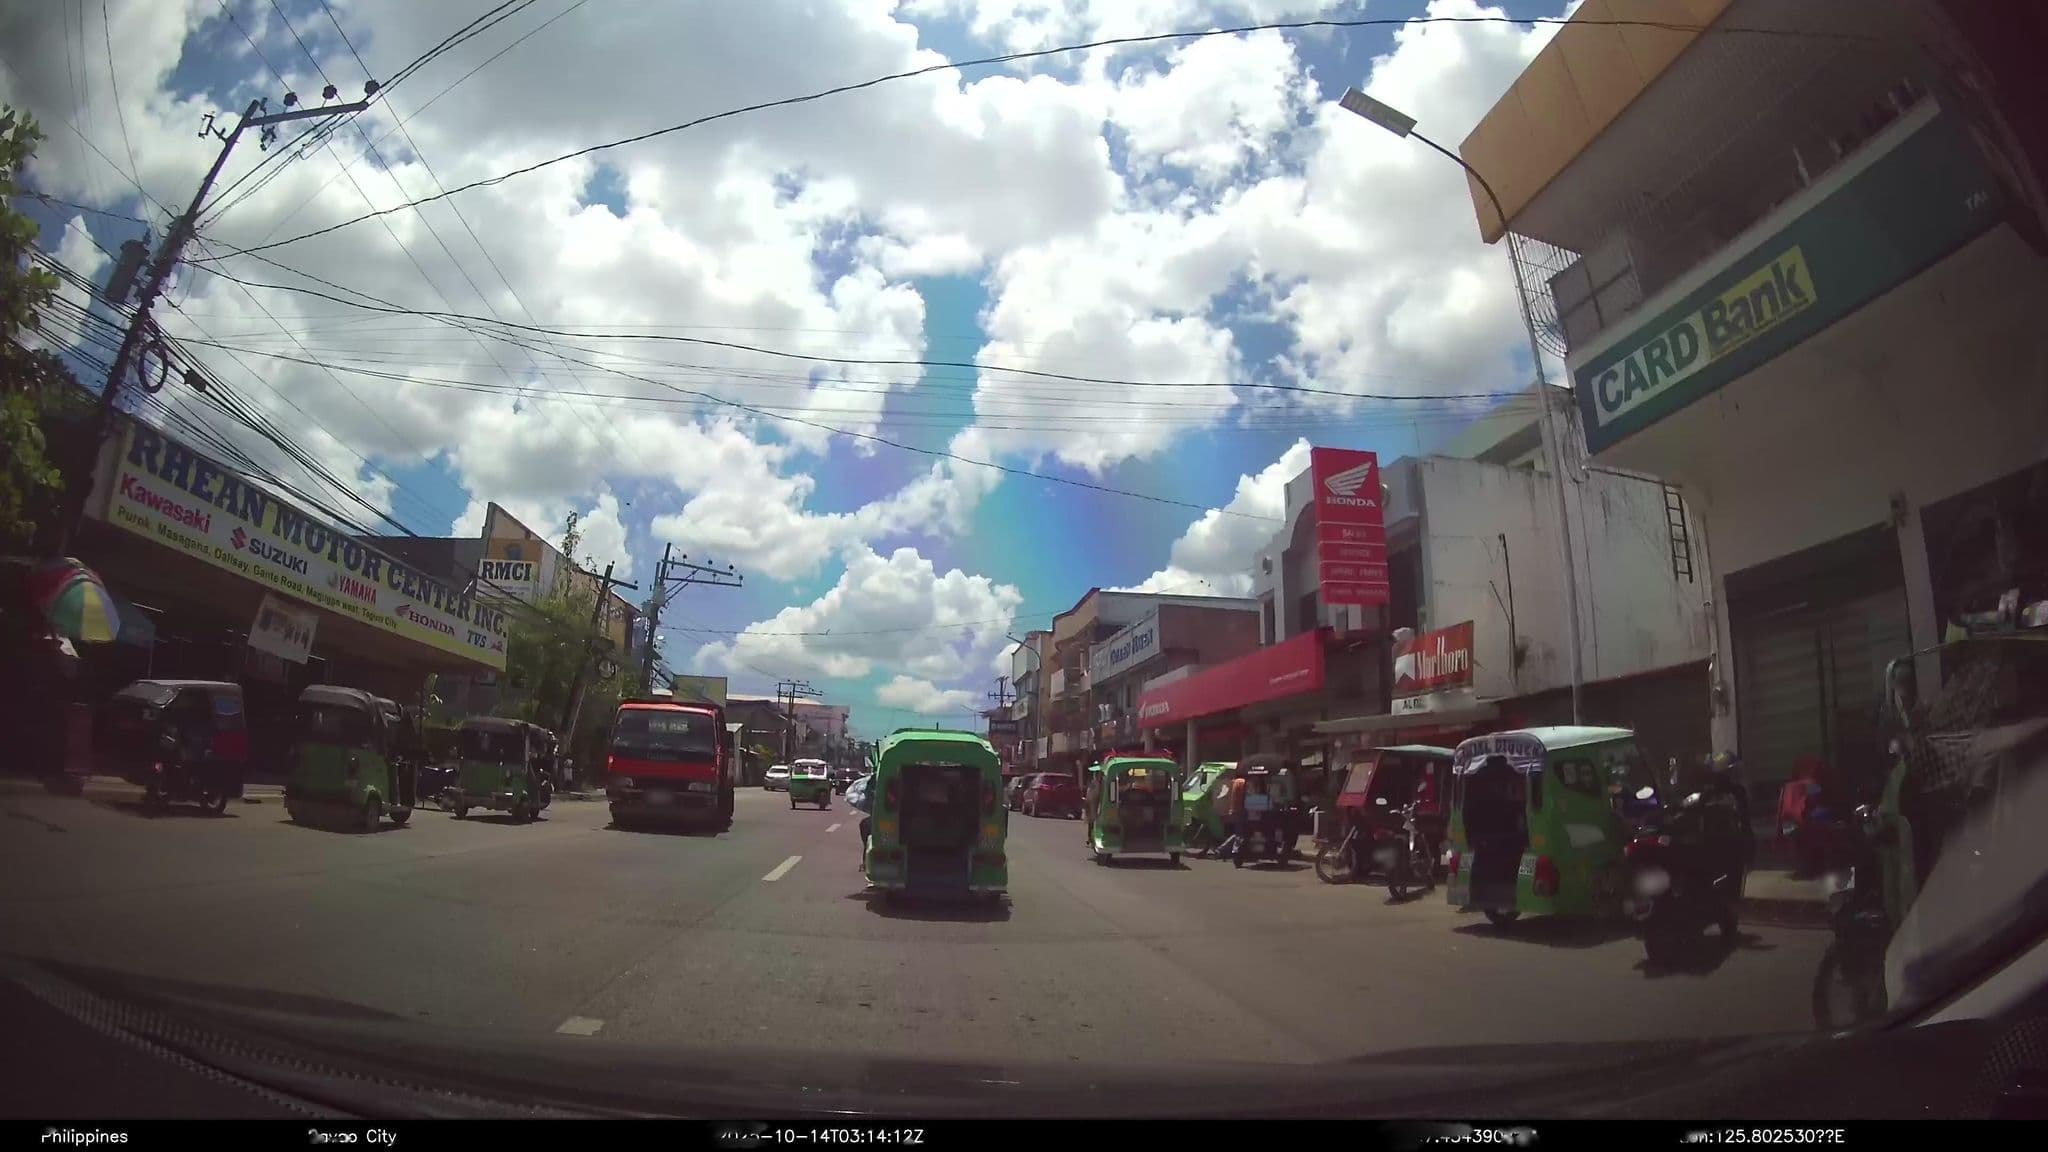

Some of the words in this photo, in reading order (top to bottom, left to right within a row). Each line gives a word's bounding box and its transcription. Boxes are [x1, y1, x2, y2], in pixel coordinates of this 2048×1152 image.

[1597, 320, 1700, 413] CARD
[1702, 260, 1811, 348] Bank
[121, 471, 210, 534] Kawasaki
[1326, 496, 1377, 508] HONDA
[127, 419, 265, 529] RHEAN
[272, 502, 381, 584] MOTOR
[387, 561, 469, 622] CENTER
[474, 602, 508, 638] INC.
[248, 537, 308, 575] SUZUKI
[482, 560, 532, 582] RMCI
[339, 575, 377, 605] YAMAHA
[408, 610, 455, 637] HONDA
[466, 629, 487, 648] TVS
[1417, 635, 1469, 681] Marlboro
